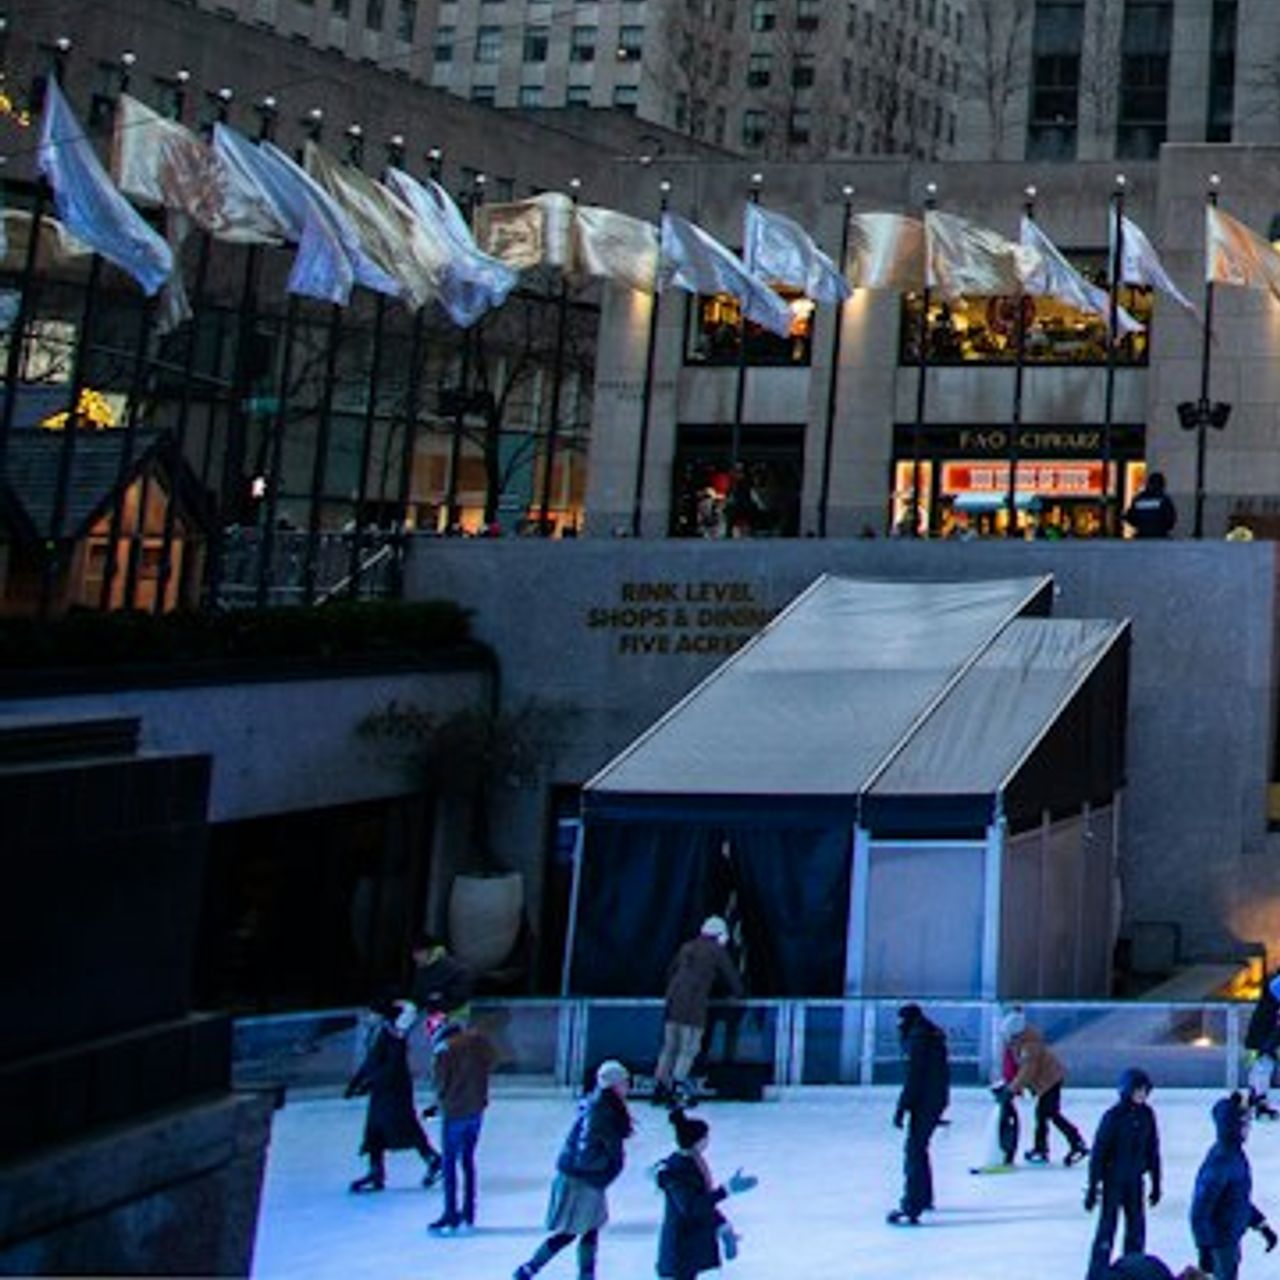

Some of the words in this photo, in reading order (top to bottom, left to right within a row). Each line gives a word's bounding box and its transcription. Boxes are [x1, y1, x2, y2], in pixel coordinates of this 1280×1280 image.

[1011, 430, 1101, 449] CHWARZ
[621, 582, 679, 602] RINK
[686, 581, 755, 602] LEVEL
[587, 608, 668, 628] SHOPS
[674, 608, 689, 627] &
[618, 632, 670, 655] FIVE
